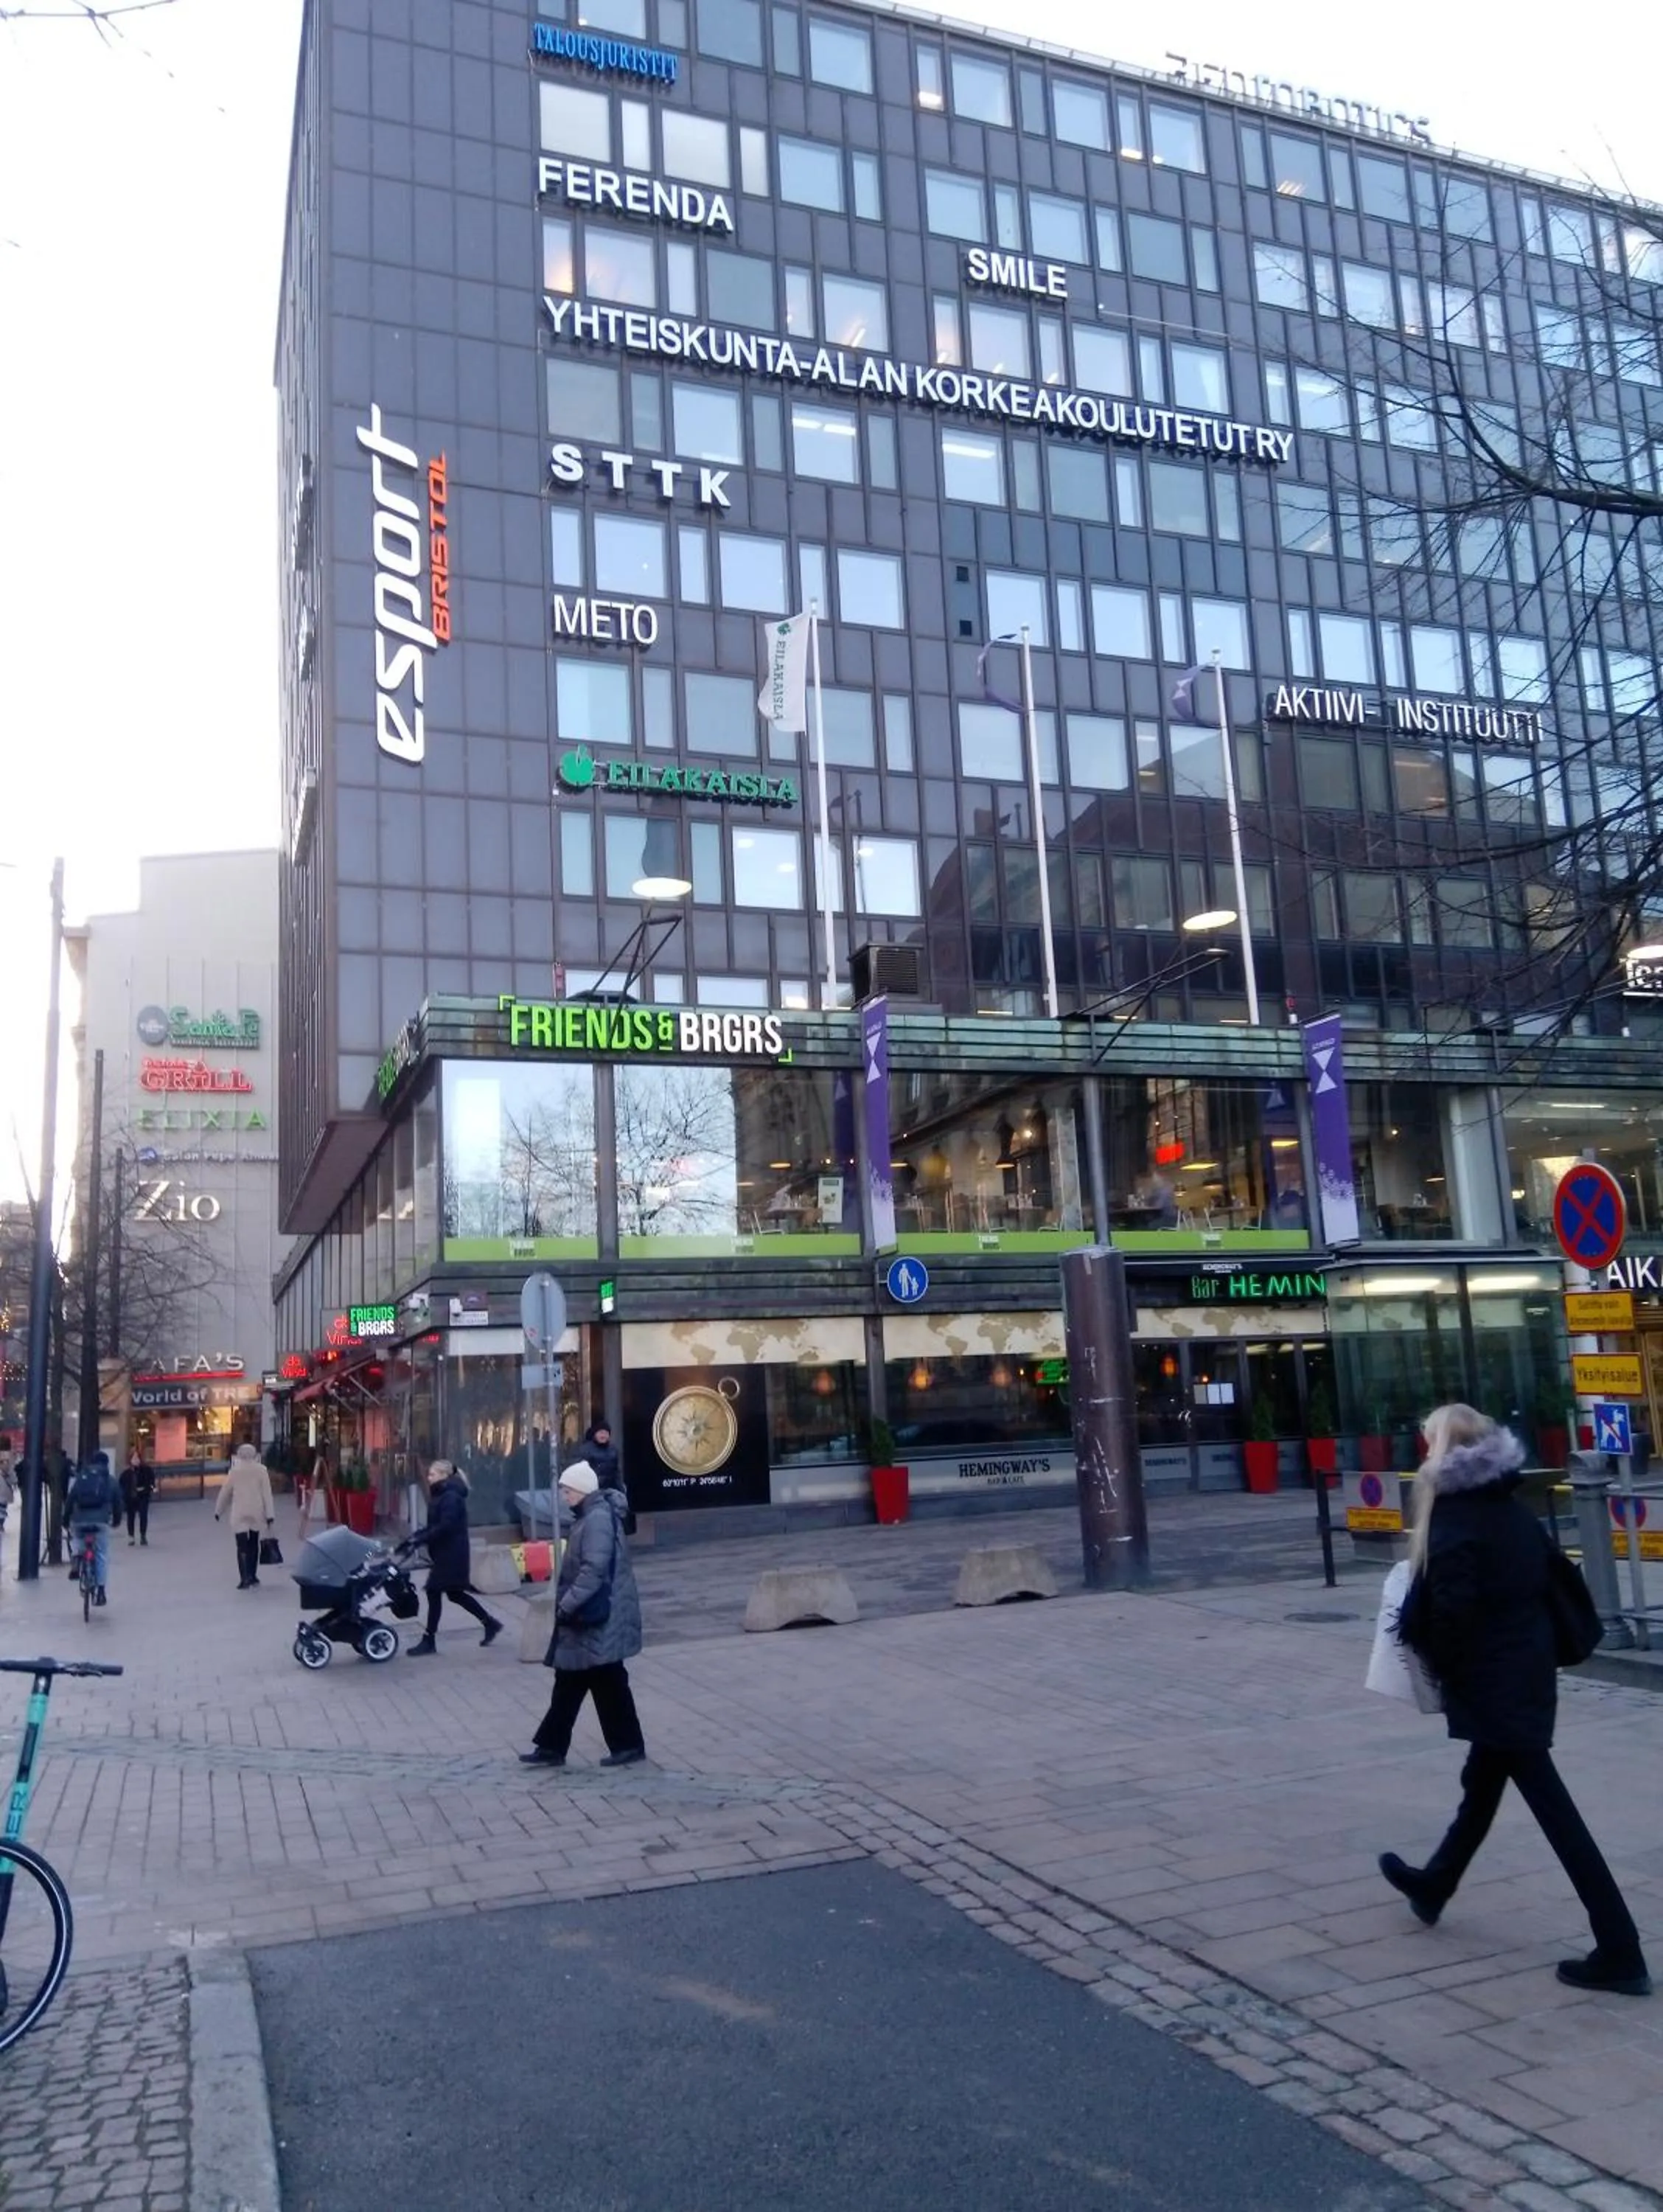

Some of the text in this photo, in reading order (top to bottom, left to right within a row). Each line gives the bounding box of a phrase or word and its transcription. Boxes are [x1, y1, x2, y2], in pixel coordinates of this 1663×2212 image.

[534, 23, 678, 81] TALOUSJURISTIT
[538, 156, 734, 232] FERENDA
[967, 248, 1068, 298] SMILE
[543, 296, 1294, 461] YHTEISKUNTA-ALAN KORKEAKOULUTETUT RY
[550, 442, 732, 508] STTK
[428, 450, 452, 645] BRISTOL
[554, 594, 658, 646] METO
[1397, 698, 1544, 743] INSTITUUTTI
[607, 759, 798, 803] EILAKAISLA
[510, 1005, 653, 1051] FRIENDS
[679, 1012, 783, 1054] BRGRS
[133, 1180, 220, 1222] Zio
[1191, 1275, 1219, 1298] Bar
[1608, 1256, 1663, 1288] AIK
[350, 1306, 394, 1322] FRIENDS
[958, 1458, 1050, 1478] HEMINGWAY'S
